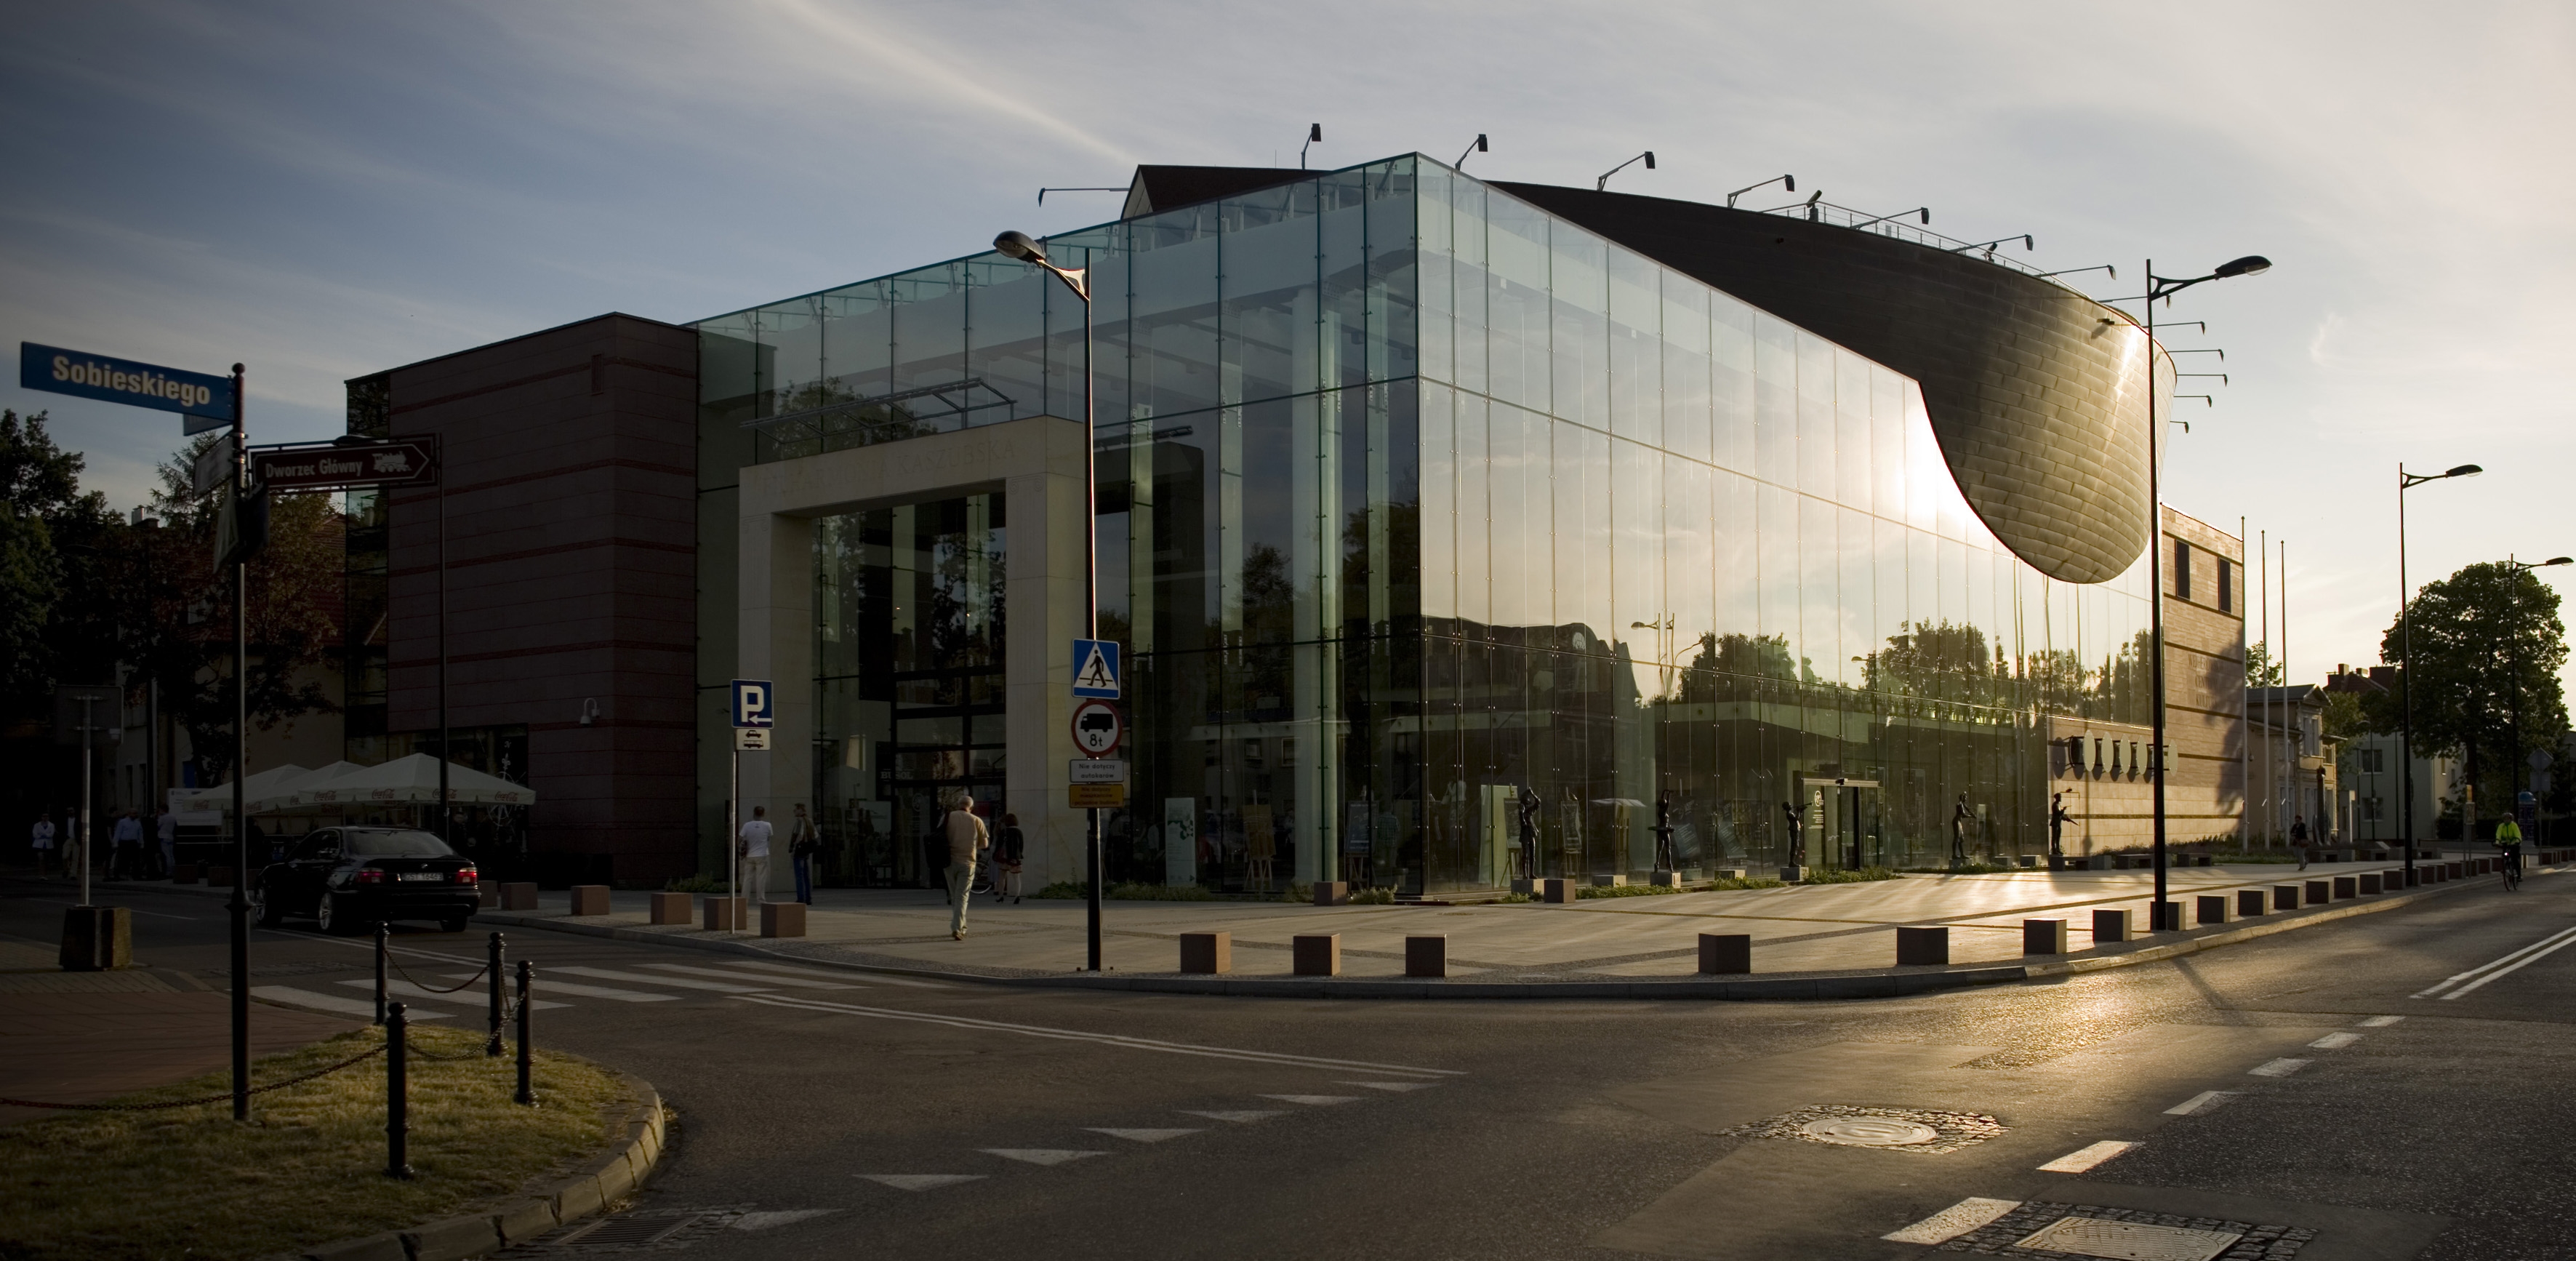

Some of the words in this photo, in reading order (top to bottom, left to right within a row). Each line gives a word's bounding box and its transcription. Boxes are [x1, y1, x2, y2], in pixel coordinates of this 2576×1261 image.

[52, 356, 211, 407] Sobieskiego
[265, 463, 316, 479] Dworzec
[318, 458, 364, 476] Główny
[740, 685, 765, 723] P
